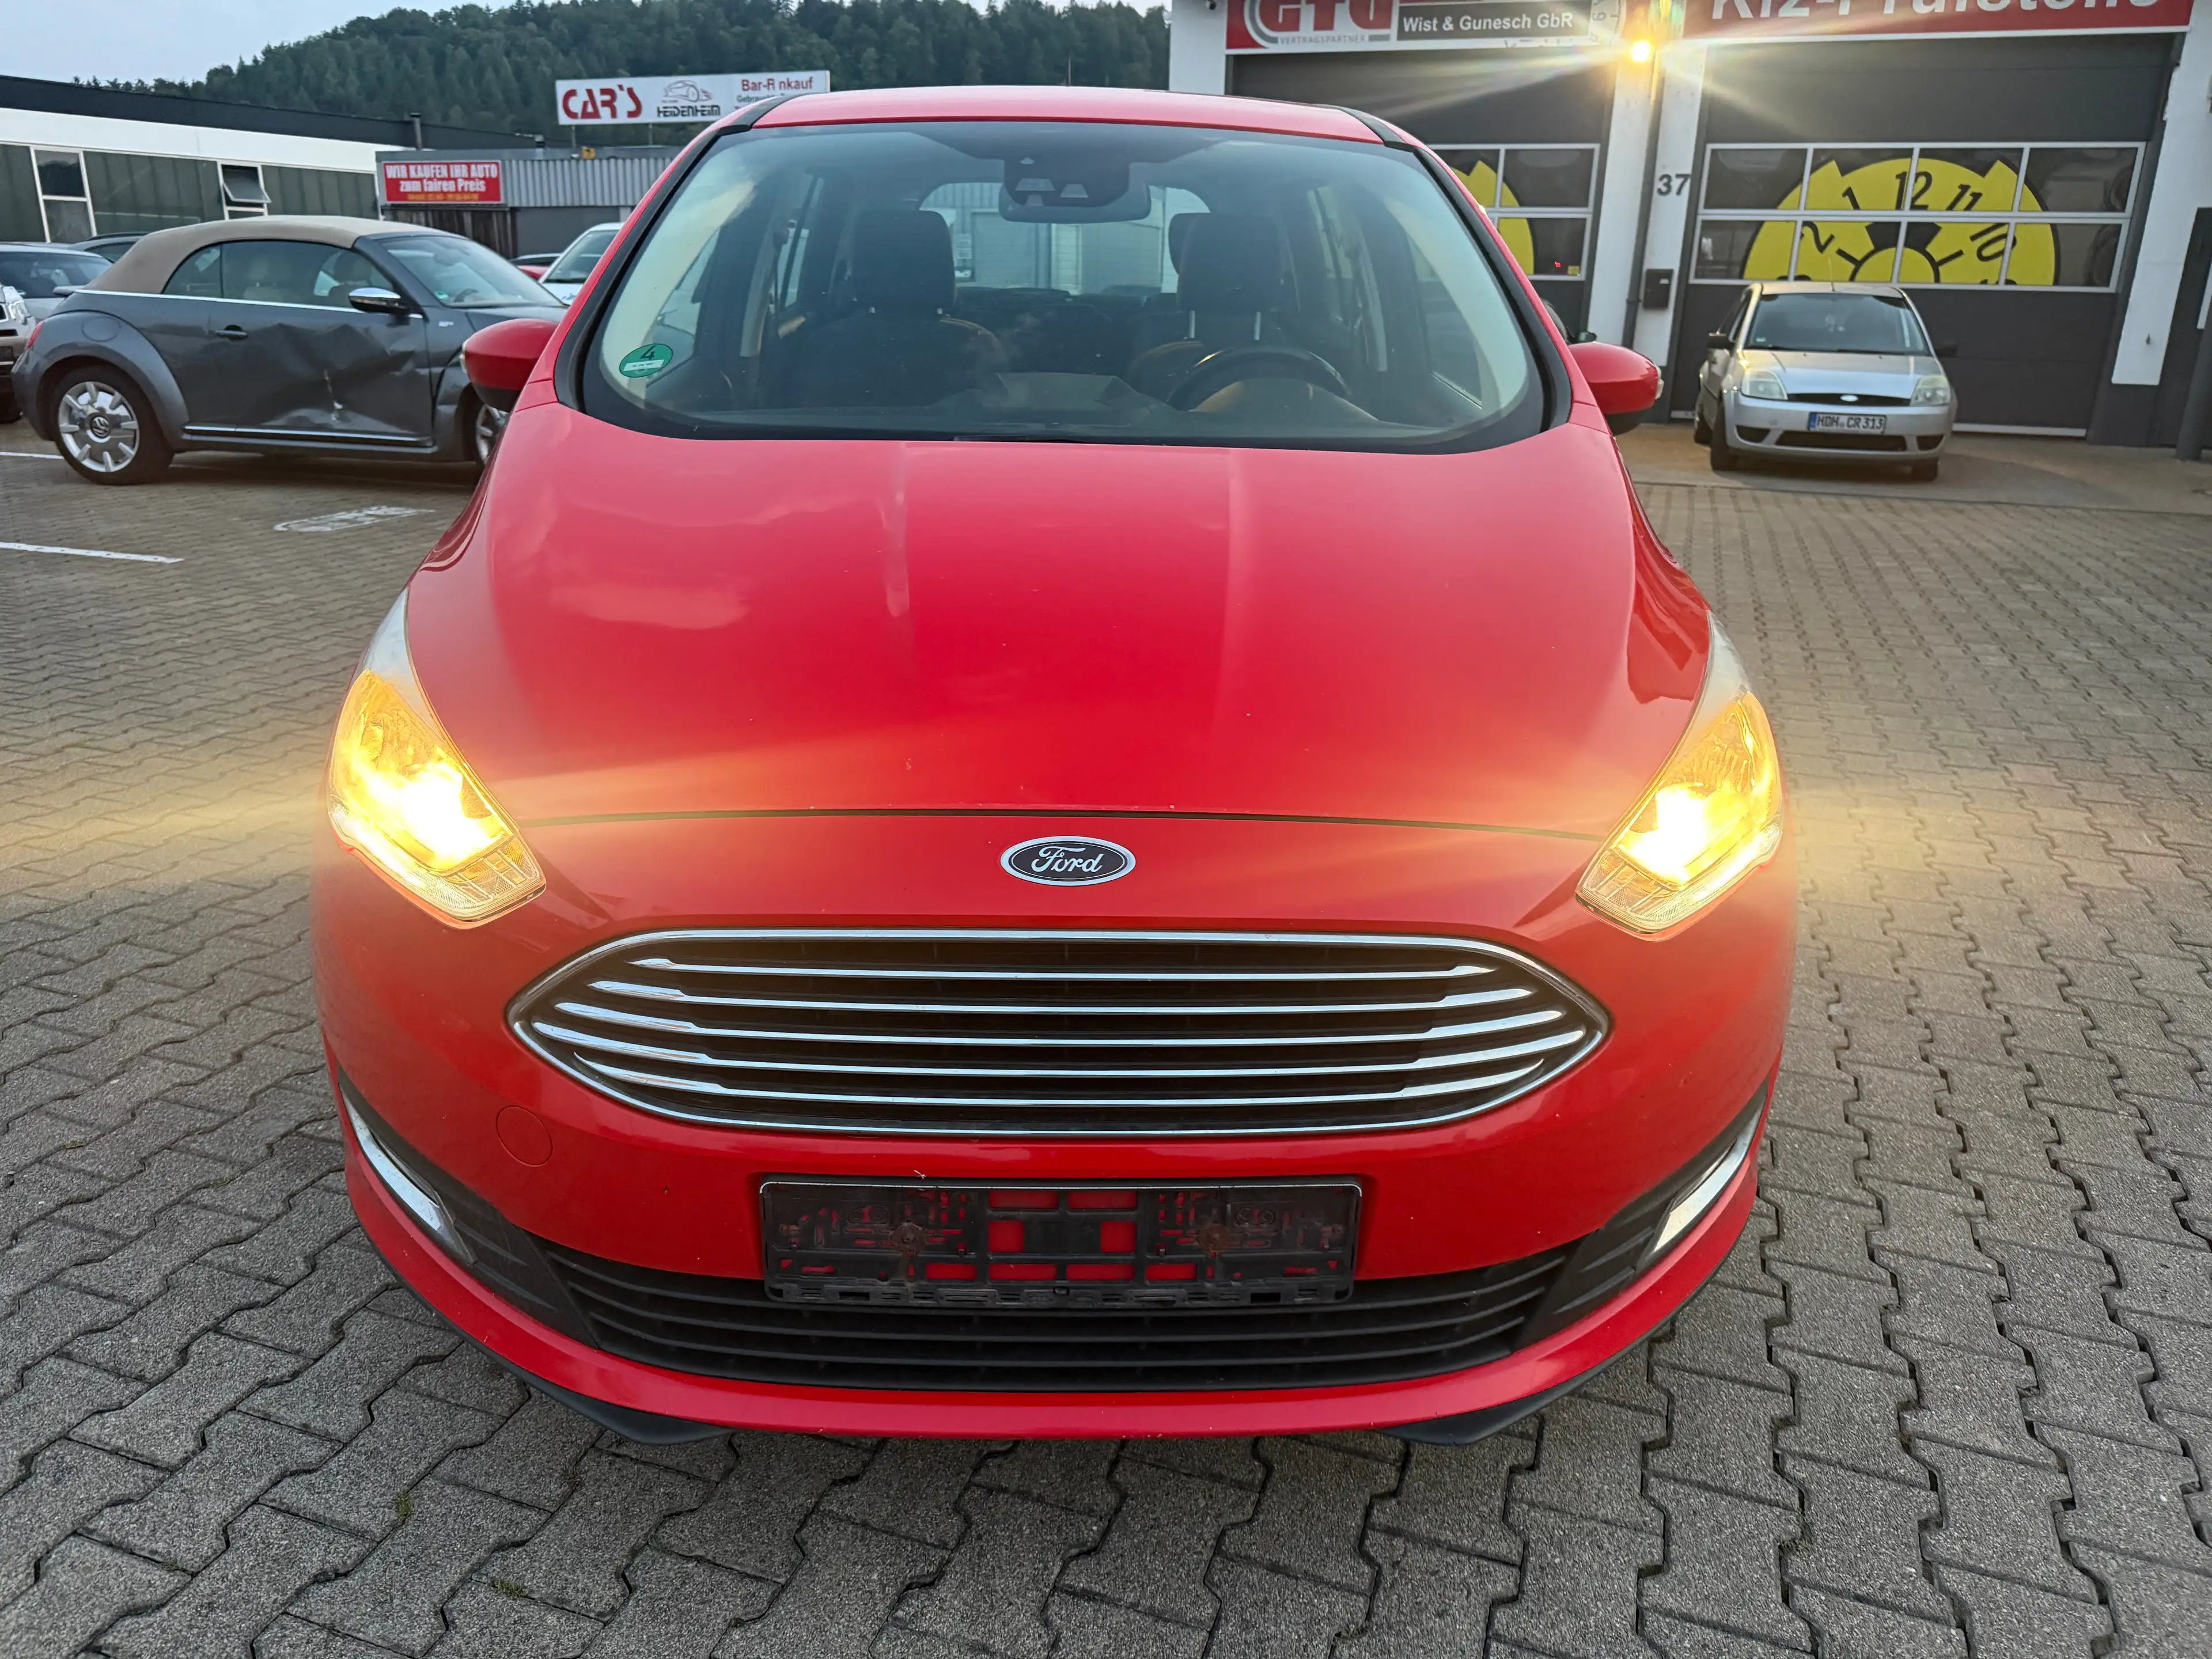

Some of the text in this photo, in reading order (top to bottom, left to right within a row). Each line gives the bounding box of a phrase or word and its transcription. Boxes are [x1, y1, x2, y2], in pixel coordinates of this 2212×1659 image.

[1403, 12, 1573, 32] Wist & Gunesch GbR
[1280, 35, 1365, 45] VERTRAGSPARTNER
[385, 165, 408, 179] WIR
[409, 164, 448, 179] KAUFEN
[470, 164, 498, 178] AUTO
[399, 178, 486, 192] zum fairen Preis
[1657, 173, 1691, 196] 37
[1895, 171, 1933, 211] 12
[639, 345, 657, 360] 4
[1031, 846, 1104, 873] Ford
